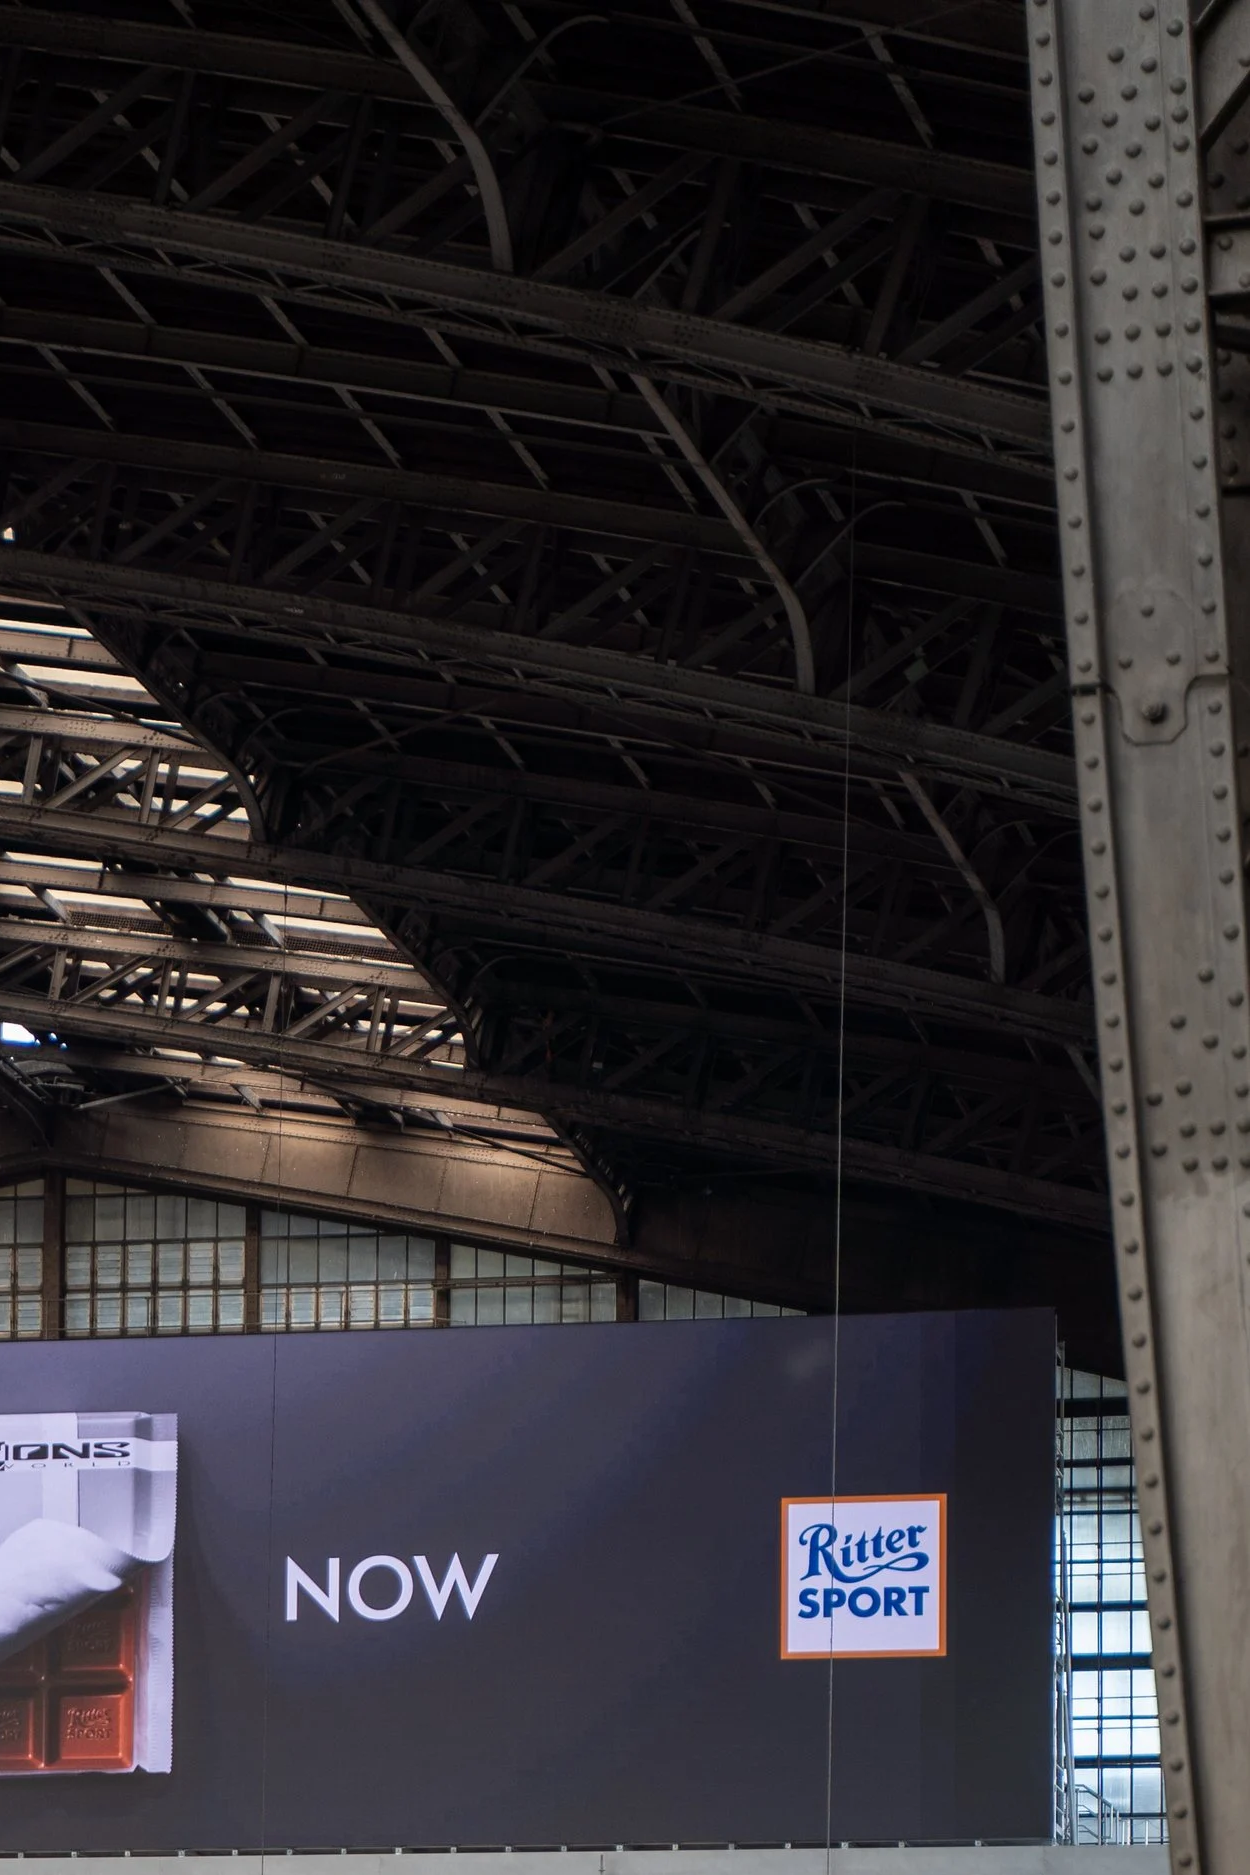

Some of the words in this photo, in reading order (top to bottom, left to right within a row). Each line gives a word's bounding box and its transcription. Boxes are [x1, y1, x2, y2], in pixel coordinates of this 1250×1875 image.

[797, 1519, 929, 1584] Ritter
[284, 1552, 500, 1623] NOW
[796, 1585, 930, 1620] SPORT
